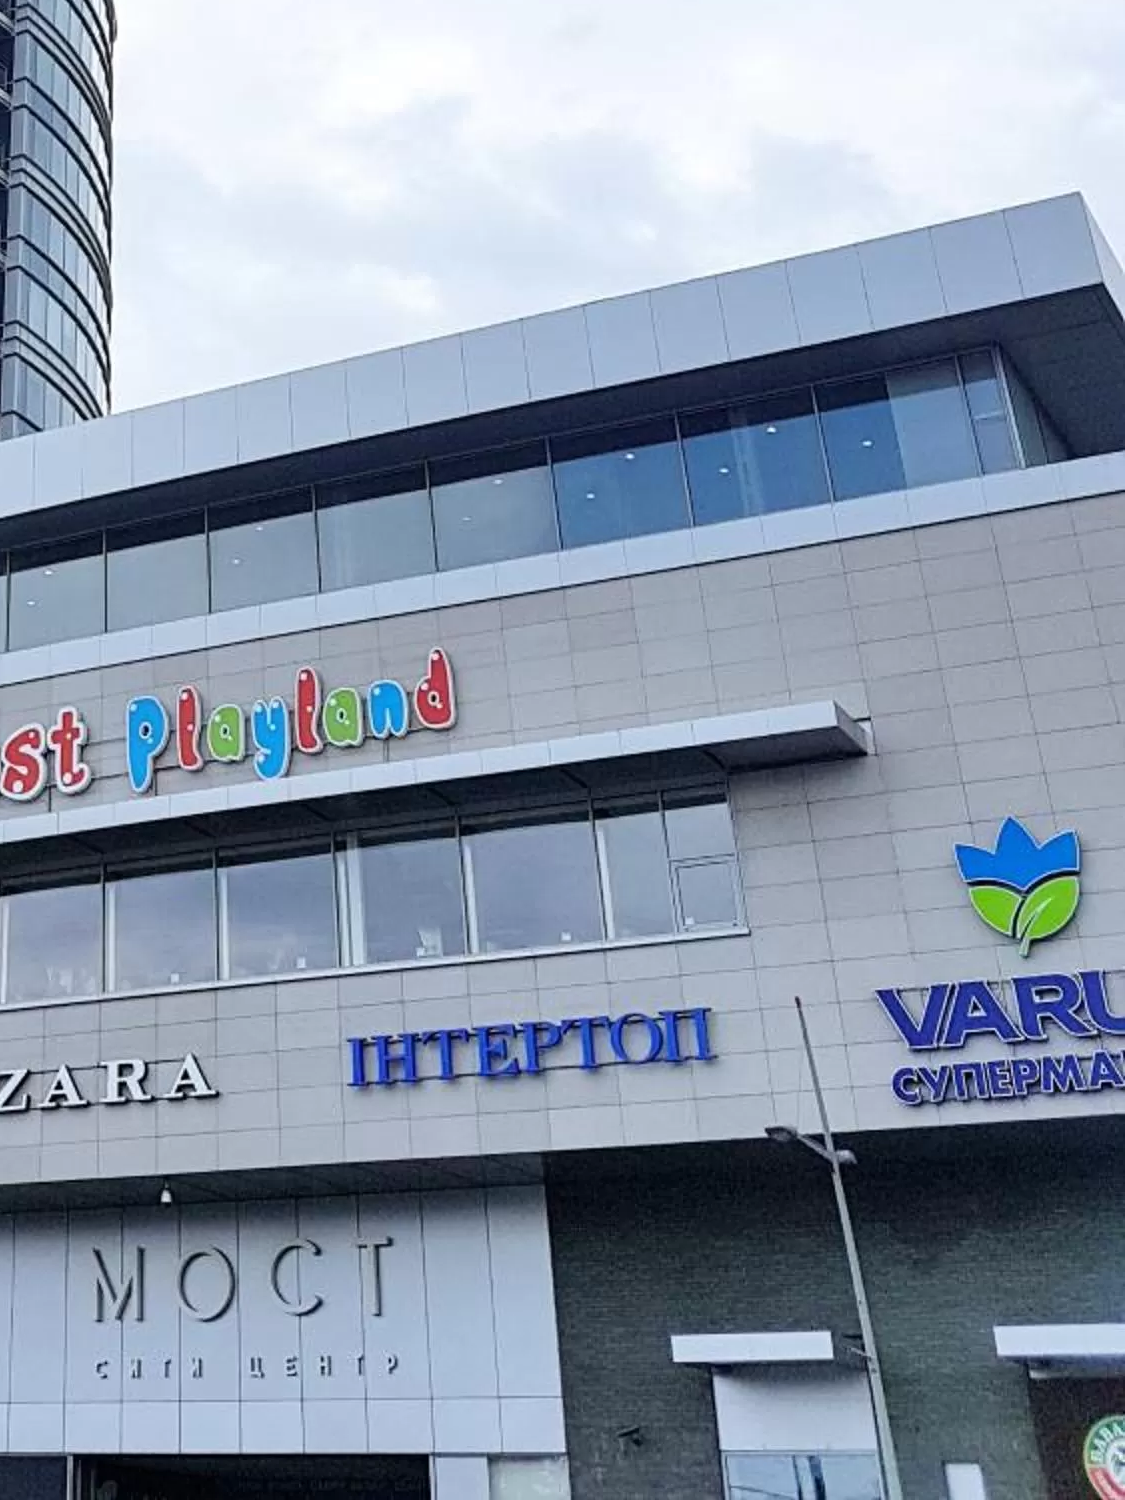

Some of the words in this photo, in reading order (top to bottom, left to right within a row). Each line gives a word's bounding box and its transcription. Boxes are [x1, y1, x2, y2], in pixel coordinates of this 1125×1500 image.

[347, 1007, 716, 1087] ІНТЕРТОП
[891, 1048, 1125, 1106] СУПЕРМА
[91, 1236, 394, 1323] МОСТ
